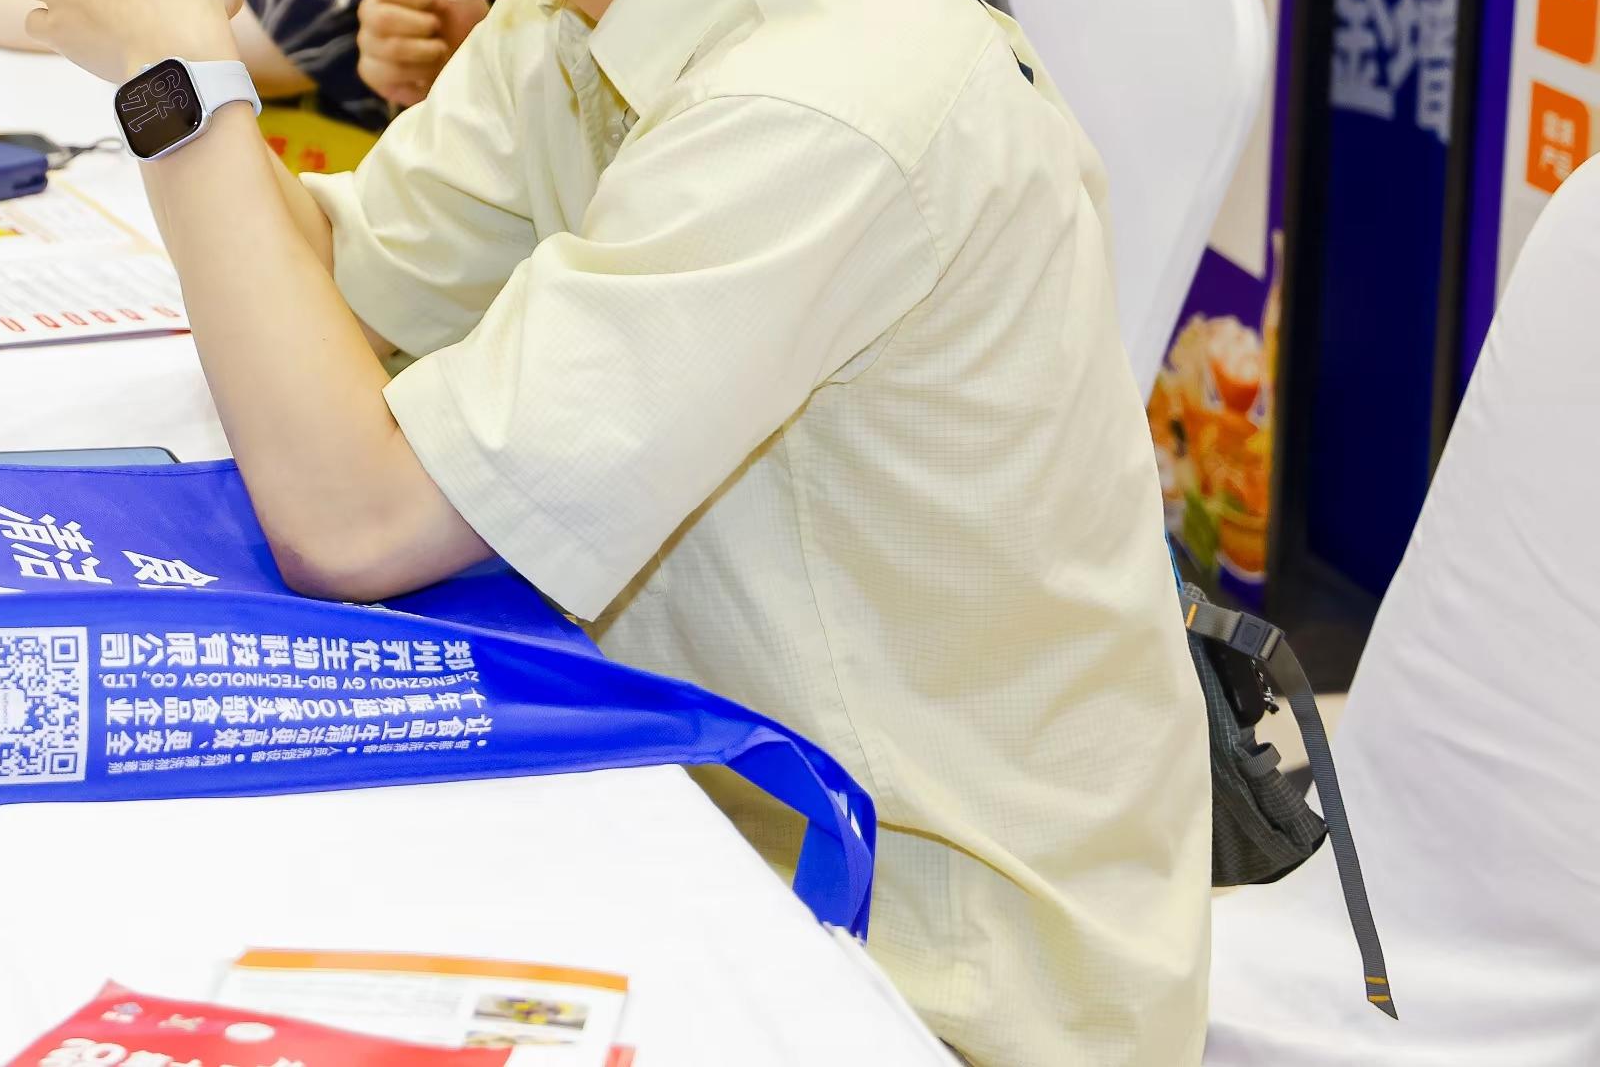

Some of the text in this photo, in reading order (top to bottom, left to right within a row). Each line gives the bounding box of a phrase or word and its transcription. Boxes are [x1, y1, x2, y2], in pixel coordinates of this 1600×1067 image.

[100, 632, 475, 672] 郑州乔优生物科技有限公司
[182, 672, 338, 690] BIO-TECHNOLOGY
[370, 671, 480, 690] ZHENGZHOU
